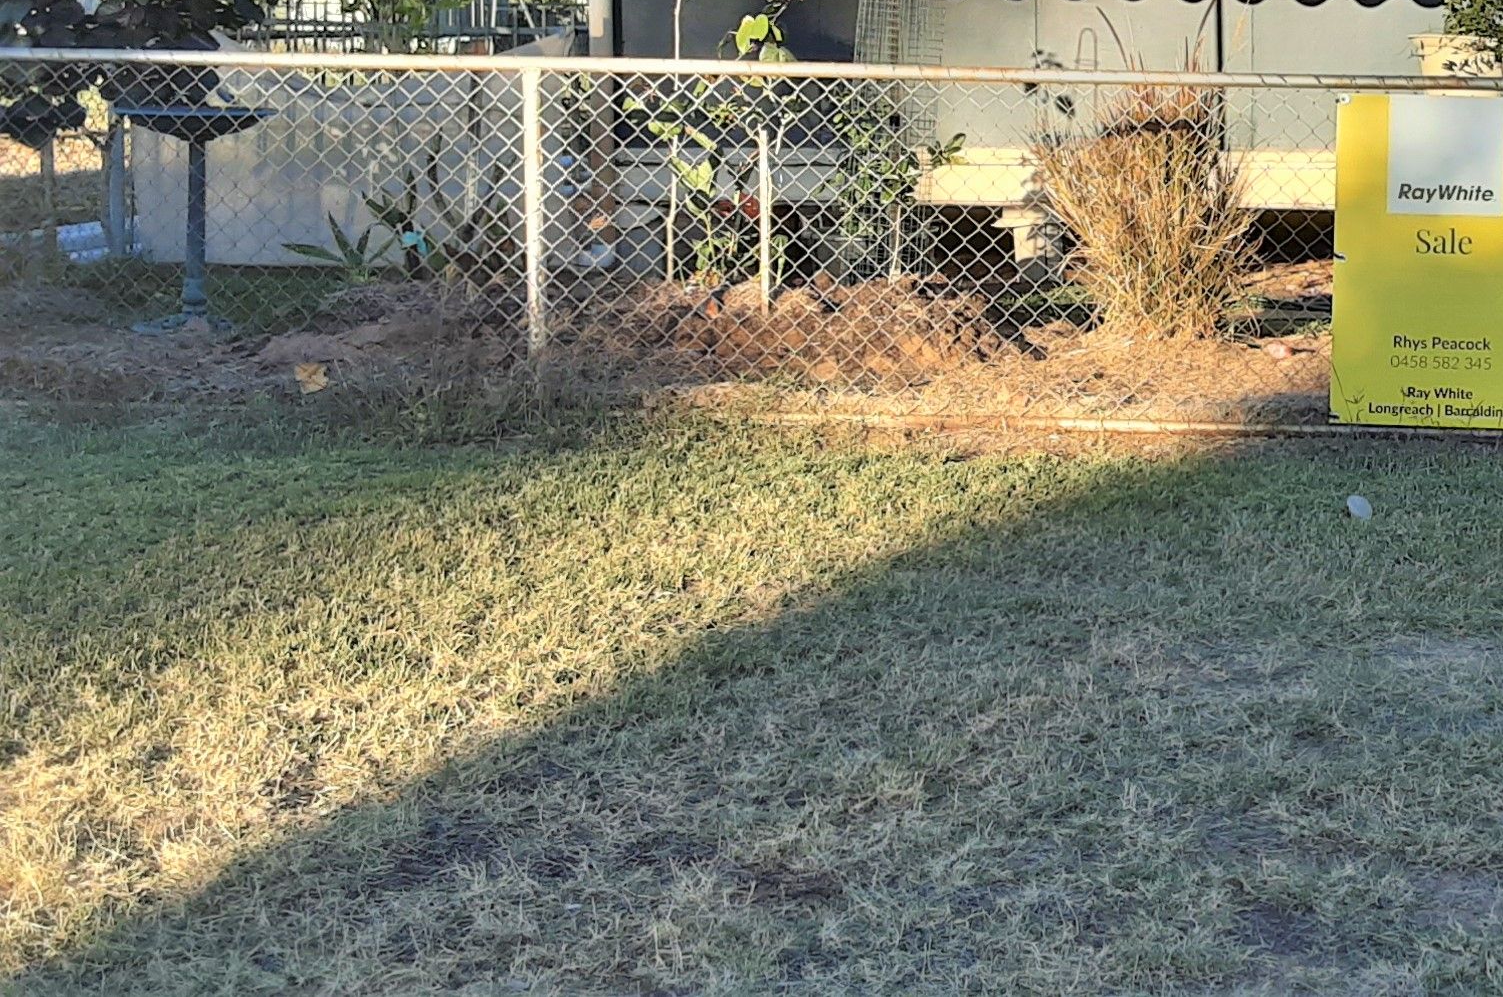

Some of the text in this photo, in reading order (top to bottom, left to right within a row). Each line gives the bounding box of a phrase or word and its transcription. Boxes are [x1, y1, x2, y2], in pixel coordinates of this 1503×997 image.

[1415, 228, 1473, 255] Sale
[1393, 335, 1491, 351] Rhys Peacock
[1390, 355, 1492, 371] 0458 582 345
[1407, 387, 1473, 401] Ray White
[1368, 402, 1434, 418] Longreach
